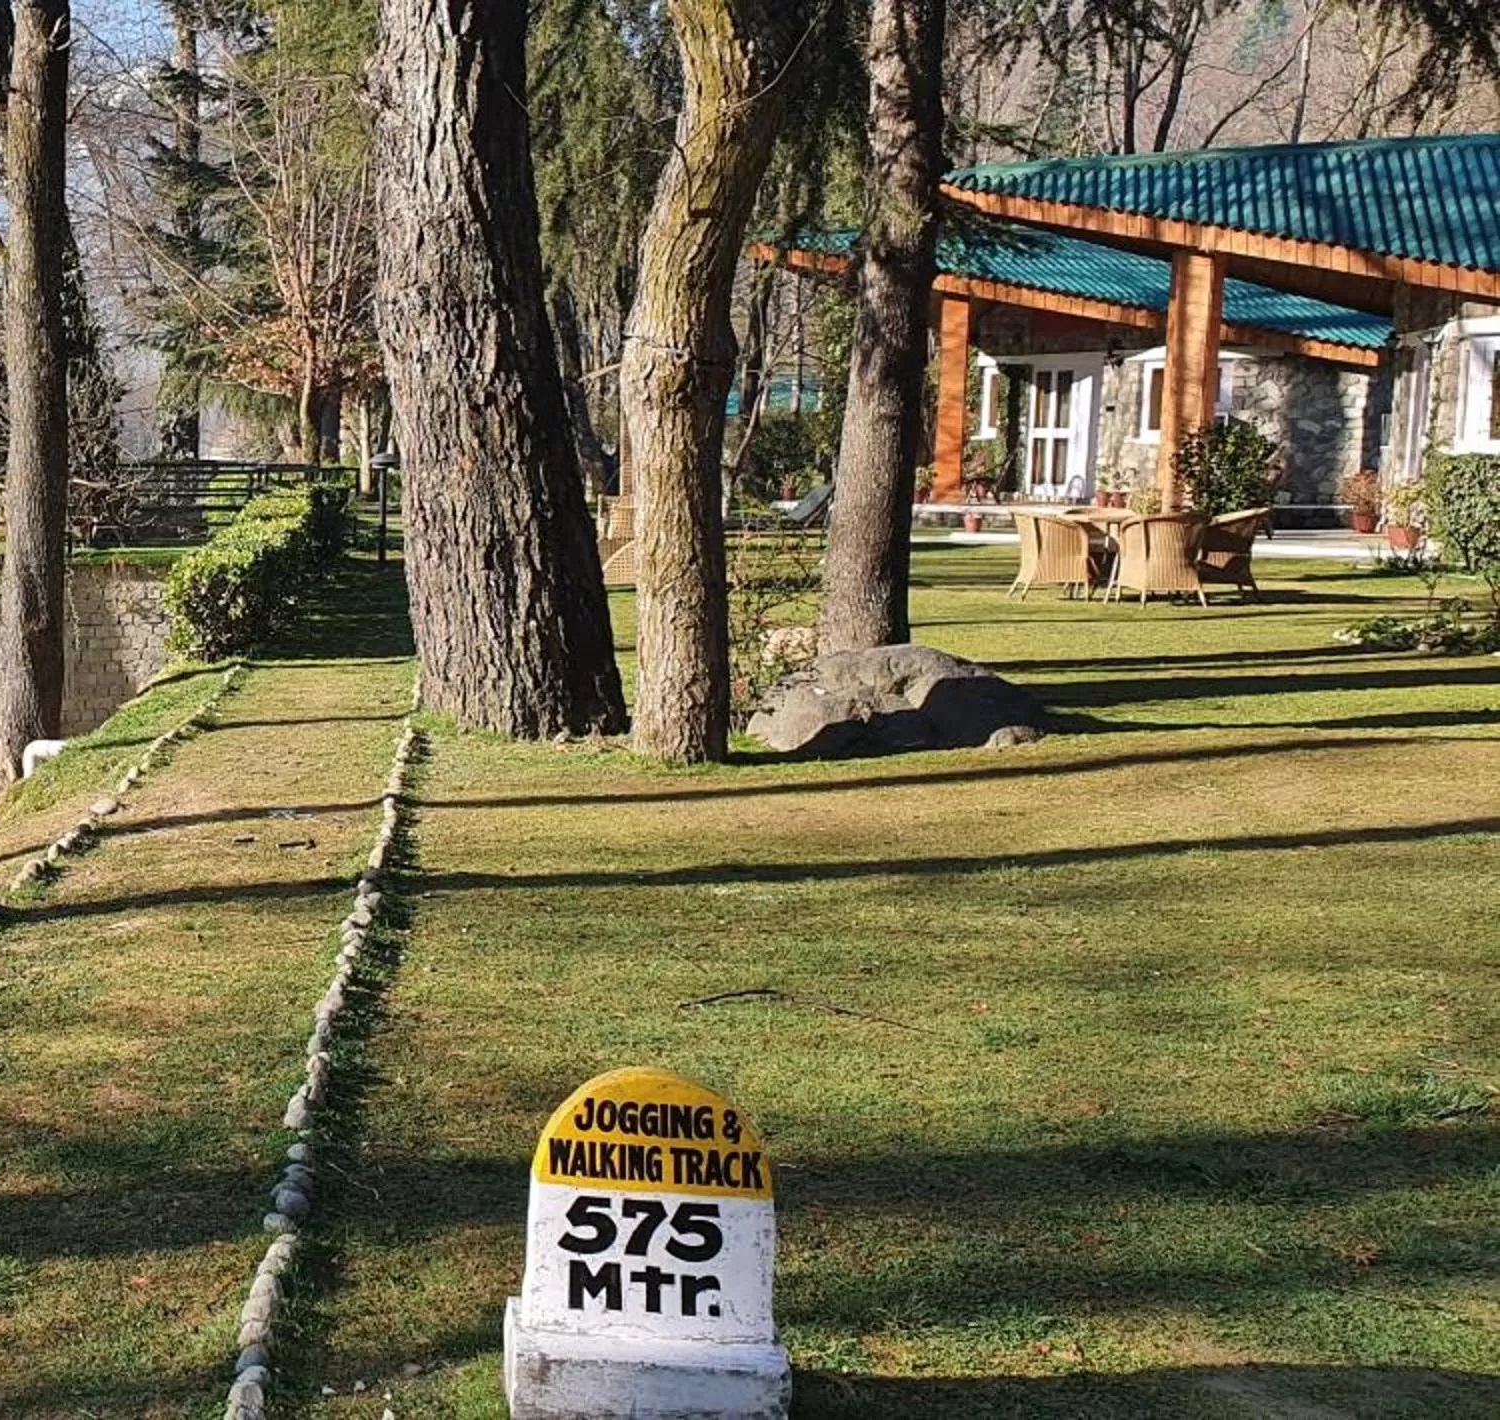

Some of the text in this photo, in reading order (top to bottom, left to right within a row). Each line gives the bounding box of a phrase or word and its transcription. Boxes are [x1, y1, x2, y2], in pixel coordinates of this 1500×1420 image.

[574, 1097, 743, 1144] JOGGING &
[549, 1137, 764, 1189] WALKING TRACK
[557, 1195, 724, 1263] 575
[568, 1259, 721, 1317] Mtr.
